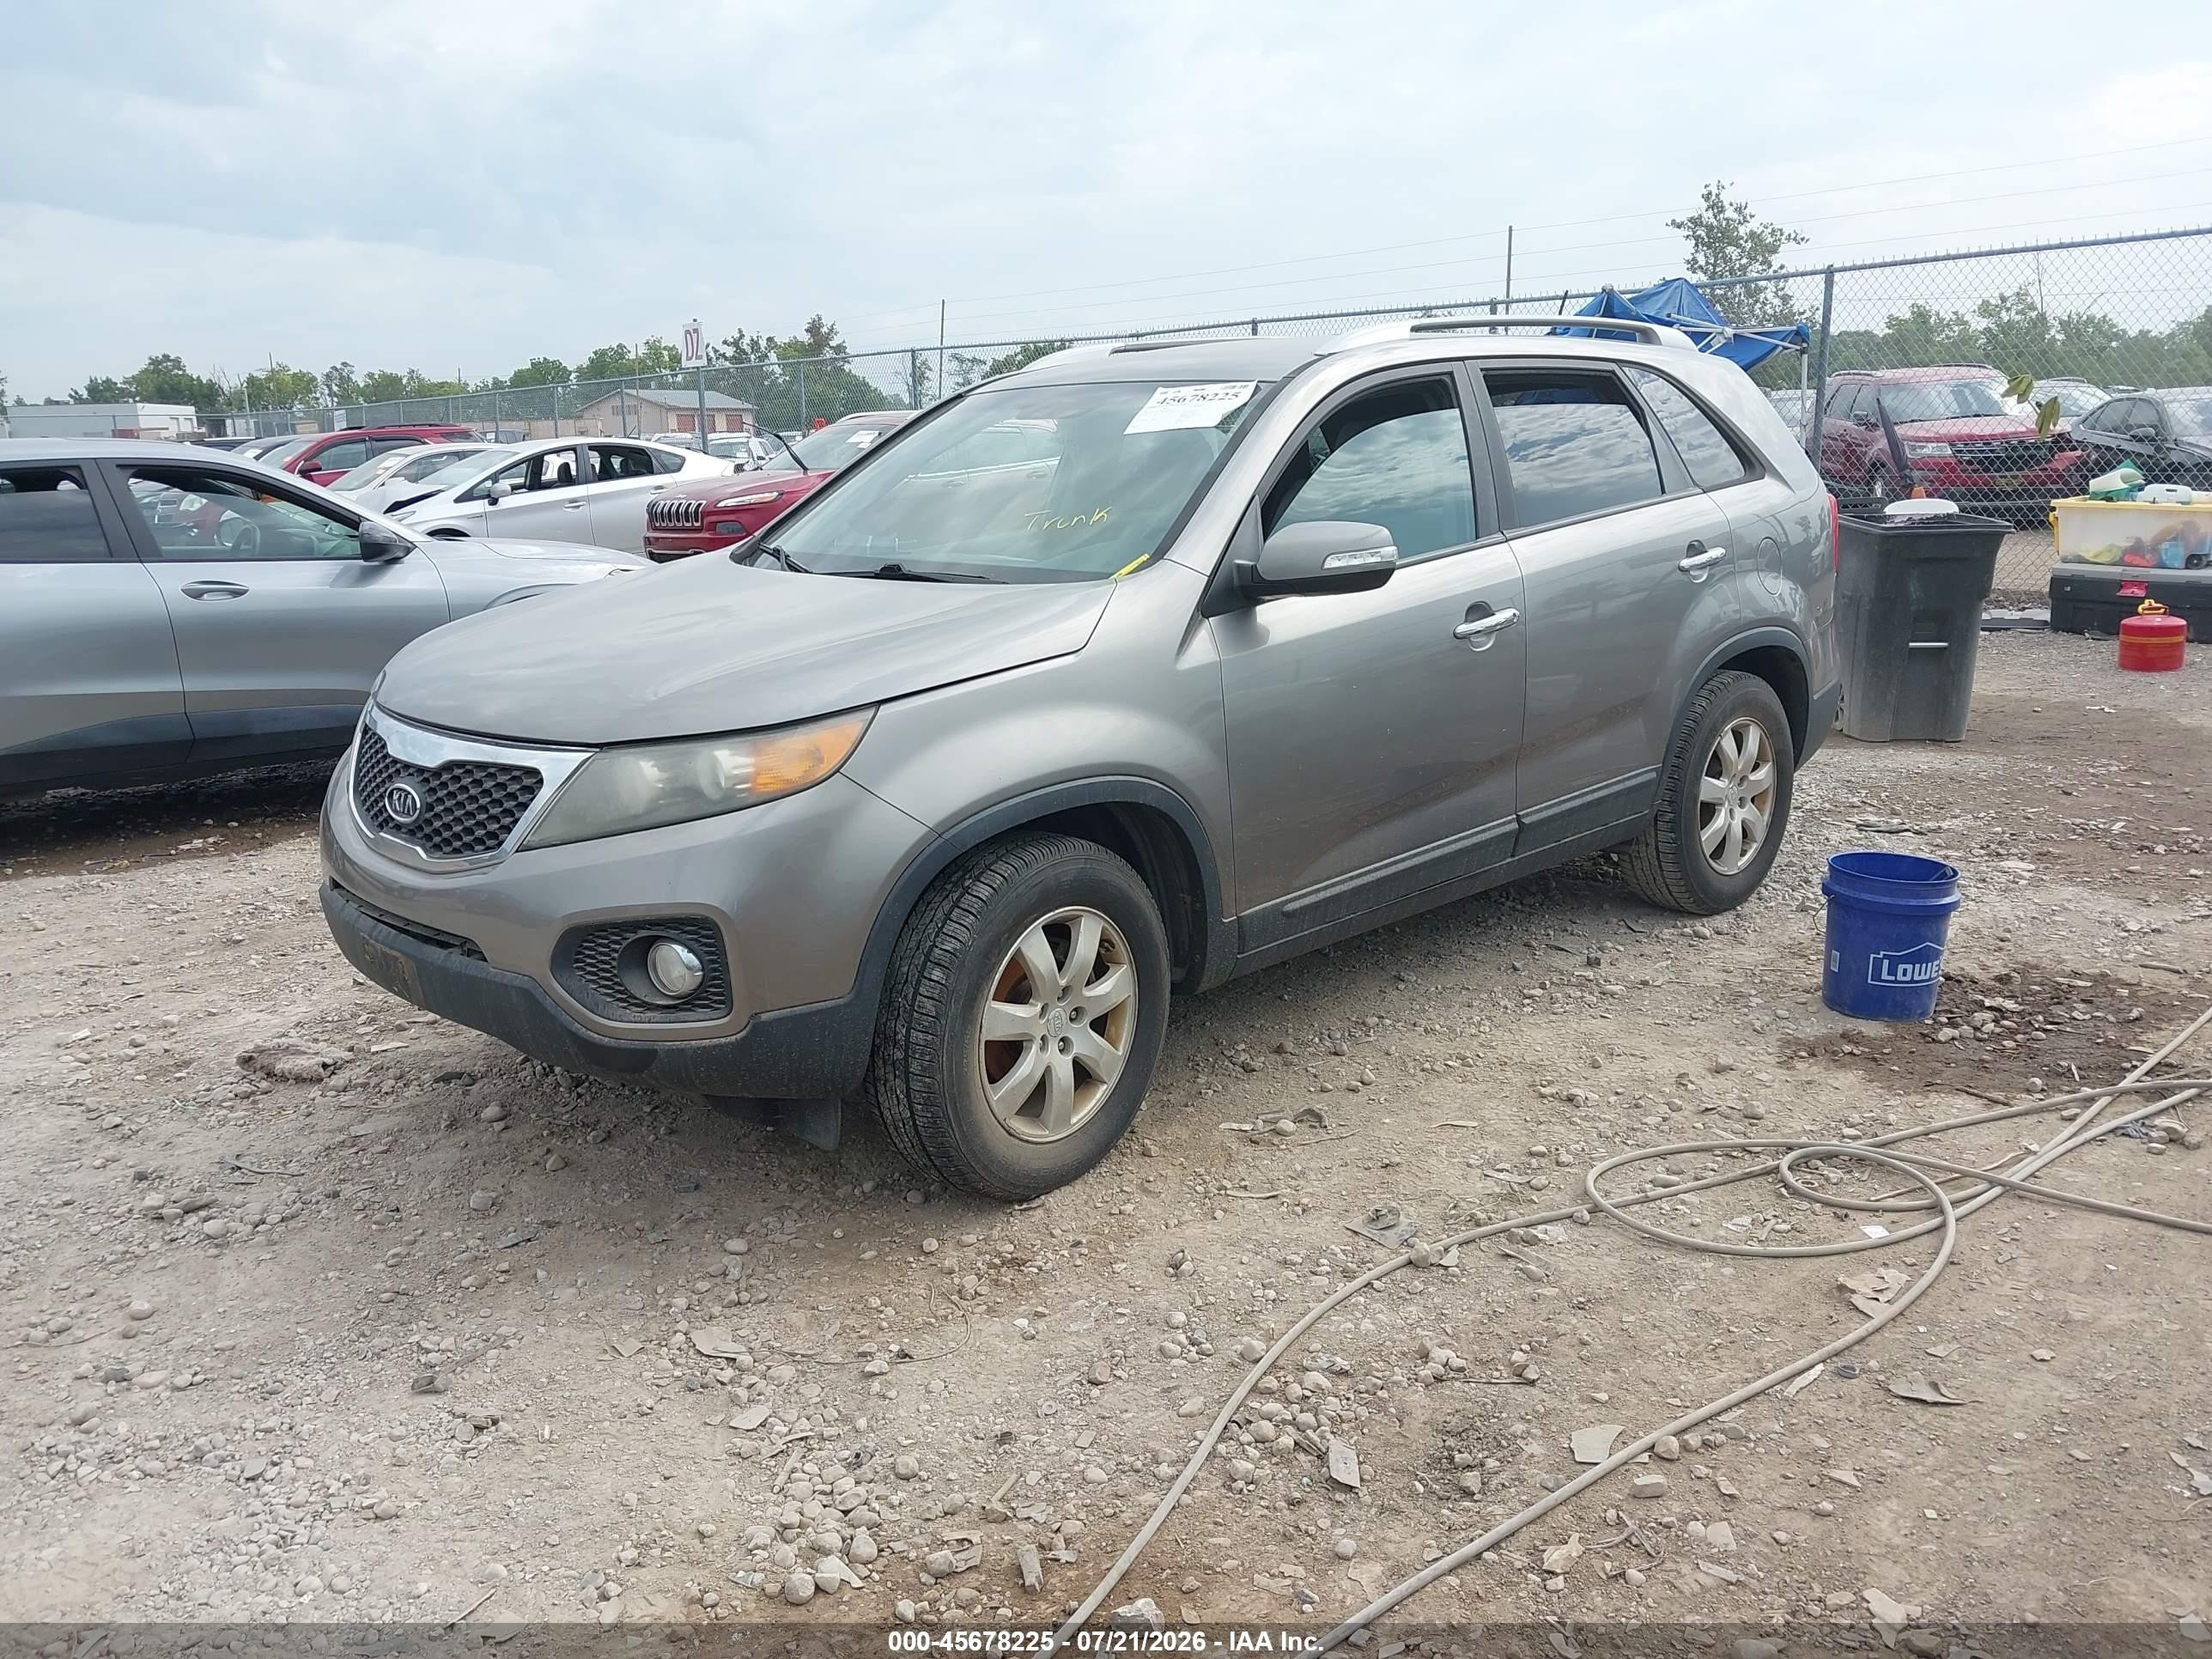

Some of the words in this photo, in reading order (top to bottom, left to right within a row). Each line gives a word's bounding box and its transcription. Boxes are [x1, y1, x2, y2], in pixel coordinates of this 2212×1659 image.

[1157, 392, 1242, 406] 45678225
[392, 790, 413, 816] KIA
[1881, 956, 1942, 981] LOWE
